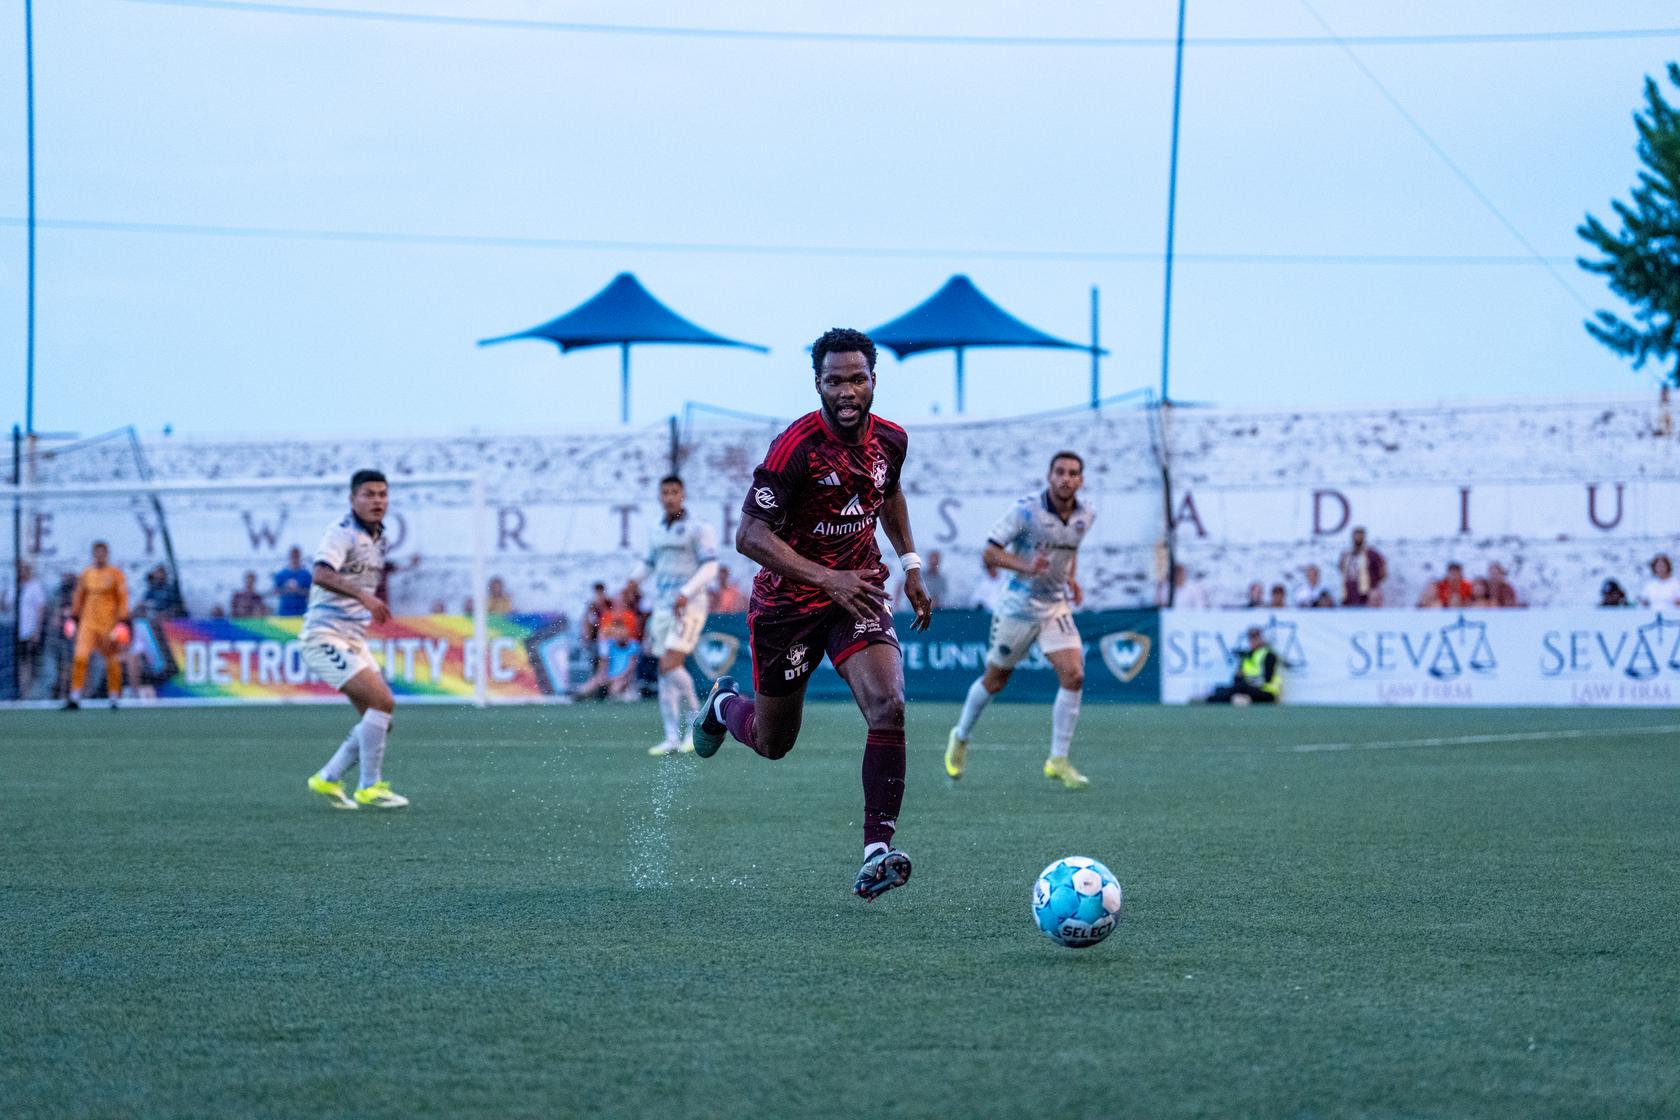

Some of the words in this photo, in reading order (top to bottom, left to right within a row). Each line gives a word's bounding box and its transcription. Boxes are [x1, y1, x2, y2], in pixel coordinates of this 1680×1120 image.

[934, 482, 1626, 545] SADIU
[184, 639, 330, 684] DETRO
[784, 661, 809, 681] DTE
[1062, 922, 1113, 939] SELECT
